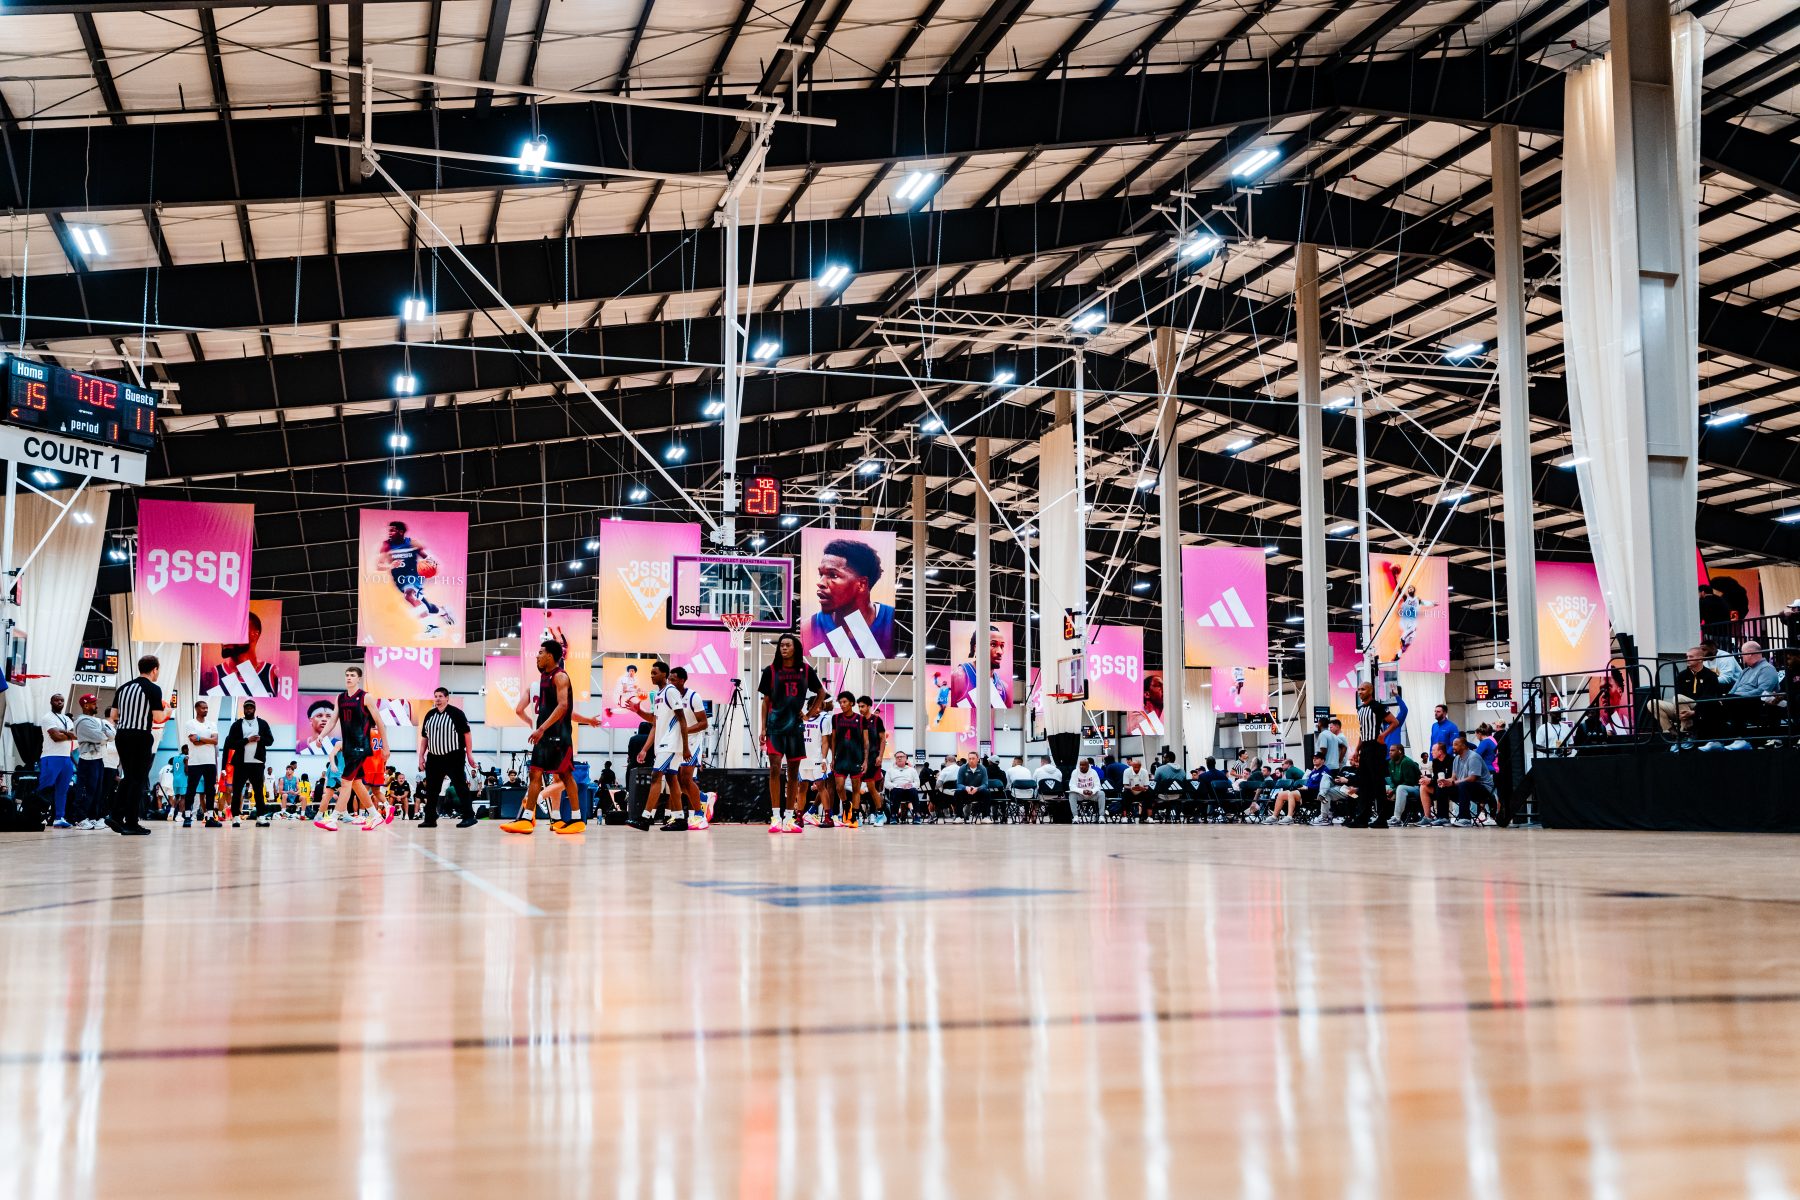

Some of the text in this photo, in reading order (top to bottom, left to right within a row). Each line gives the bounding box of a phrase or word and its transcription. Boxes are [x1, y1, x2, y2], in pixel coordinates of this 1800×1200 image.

[17, 362, 43, 379] Home
[26, 382, 47, 411] 15
[71, 374, 118, 409] 7:02
[125, 388, 154, 406] Guests
[71, 419, 99, 434] period
[136, 407, 155, 433] 11
[113, 423, 118, 442] 1
[24, 436, 120, 474] COURT 1
[756, 478, 774, 489] 7:02
[747, 488, 777, 513] 20
[147, 549, 241, 598] 3SSB
[364, 575, 464, 585] YOU GOT THIS
[629, 560, 671, 585] 3SSB
[679, 605, 700, 617] 3SSB
[1556, 595, 1588, 616] 3SSB
[106, 656, 118, 667] 29
[1089, 655, 1138, 683] 3SSB
[101, 676, 107, 684] 3
[502, 676, 520, 689] 3SS
[785, 682, 798, 697] 13
[845, 729, 852, 740] 4
[175, 762, 179, 770] 9
